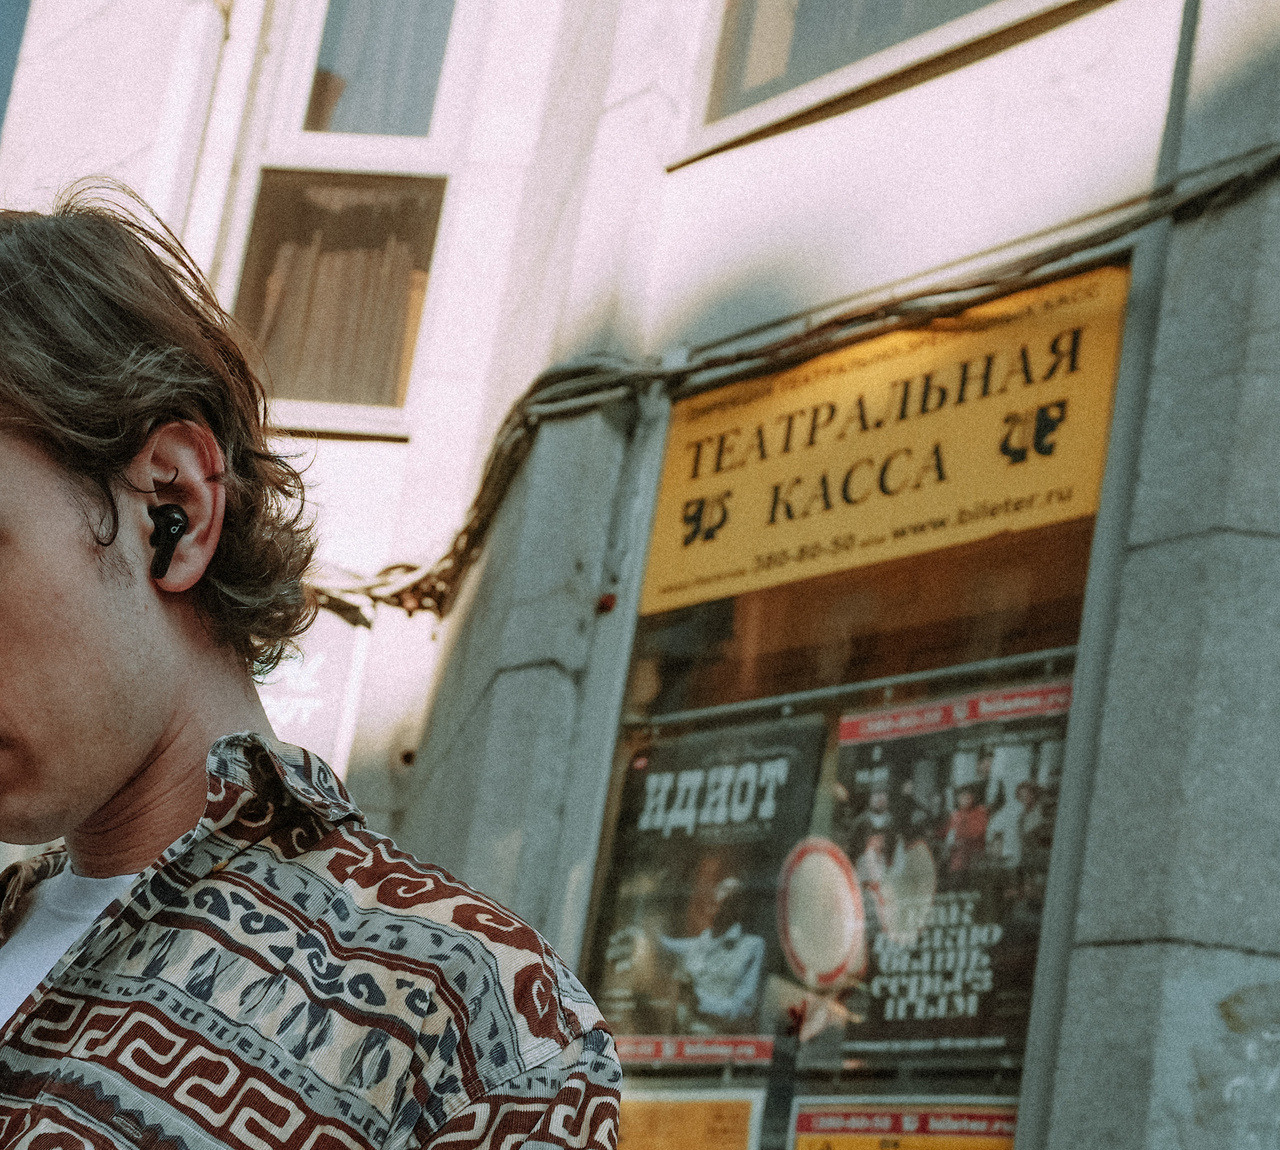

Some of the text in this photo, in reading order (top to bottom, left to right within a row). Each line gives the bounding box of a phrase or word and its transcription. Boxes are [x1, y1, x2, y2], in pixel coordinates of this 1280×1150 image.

[685, 326, 1086, 480] ТЕАТРАЛЬНАЯ
[766, 439, 950, 526] КАССА
[637, 757, 790, 839] ИДИОТ
